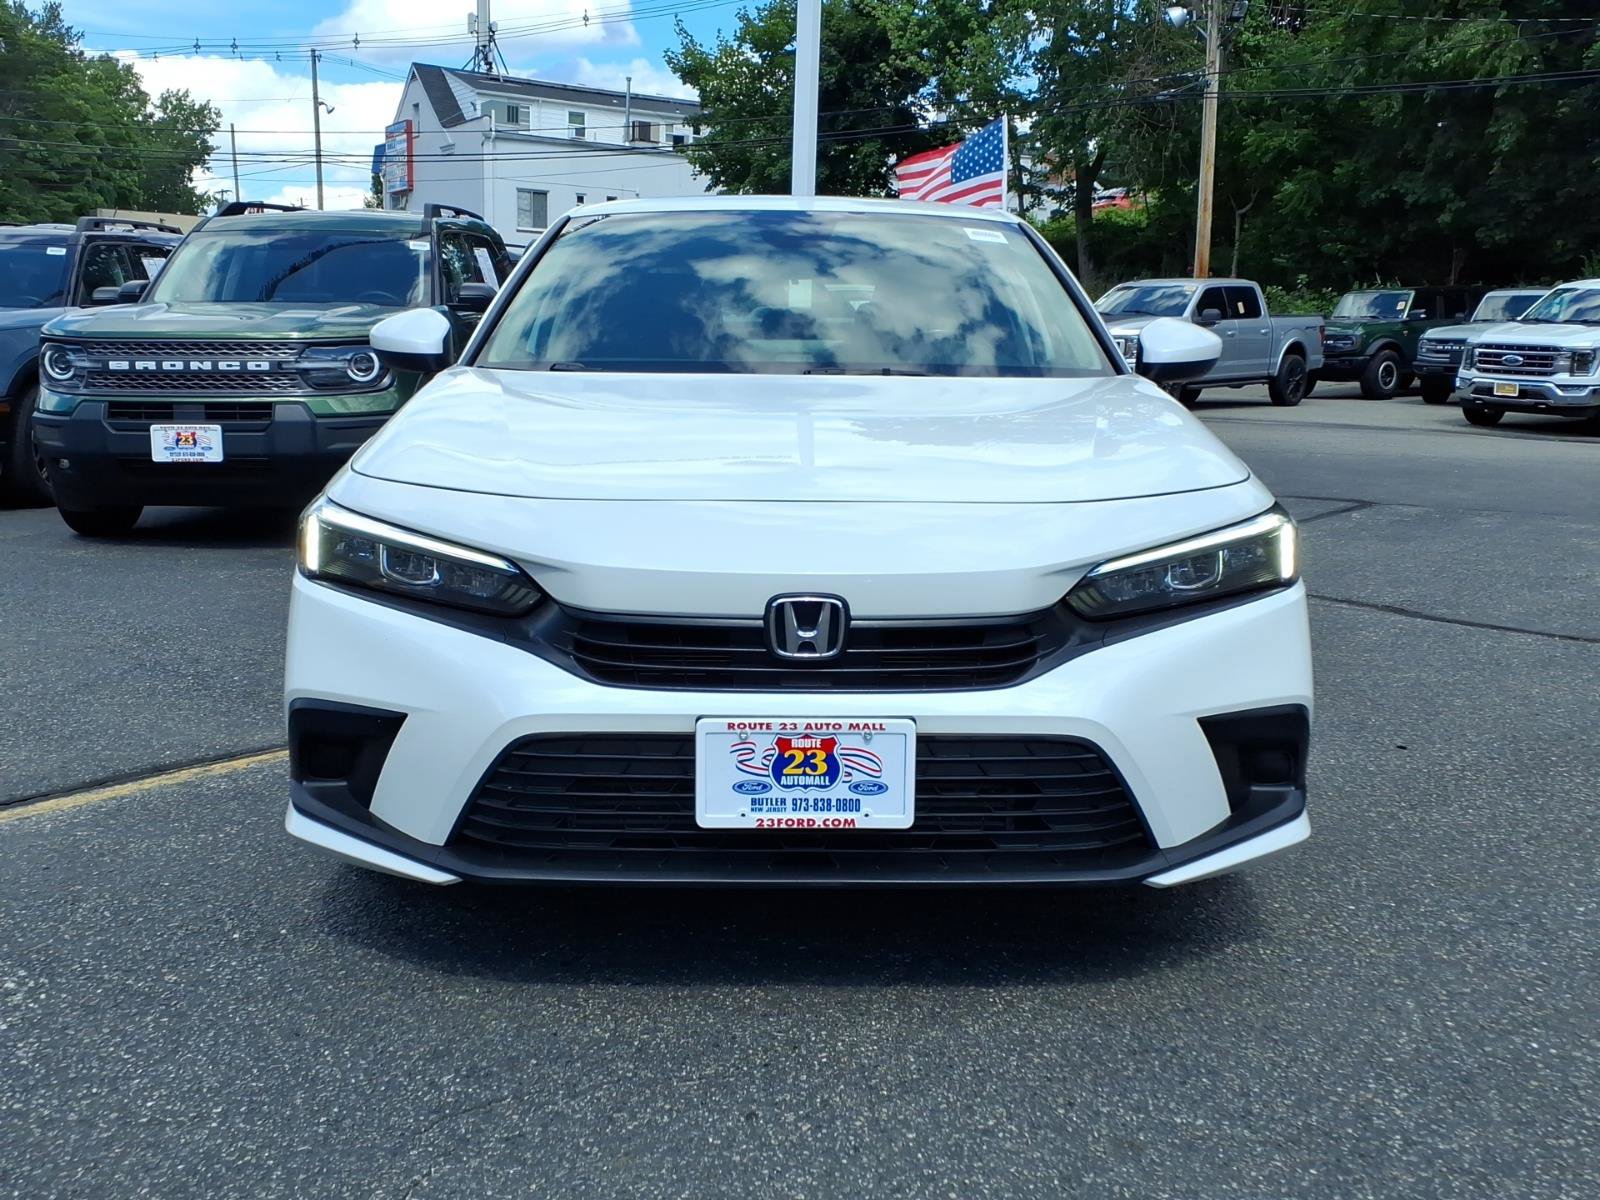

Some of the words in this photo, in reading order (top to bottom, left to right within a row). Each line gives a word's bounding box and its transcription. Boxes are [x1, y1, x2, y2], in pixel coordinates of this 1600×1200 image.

[108, 361, 270, 370] BRONCO
[178, 435, 194, 446] 23
[727, 722, 773, 731] ROUTE
[778, 722, 798, 731] 23
[804, 722, 842, 731] AUTO
[848, 722, 886, 731] MALL
[791, 738, 822, 749] ROUTE
[782, 749, 828, 776] 23
[780, 775, 830, 786] AUTOMALL
[741, 782, 763, 792] Ford
[857, 782, 879, 792] Ford
[750, 797, 787, 807] BUTLER
[791, 797, 861, 813] 973-838-0800
[755, 818, 857, 828] 23FORD.COM
